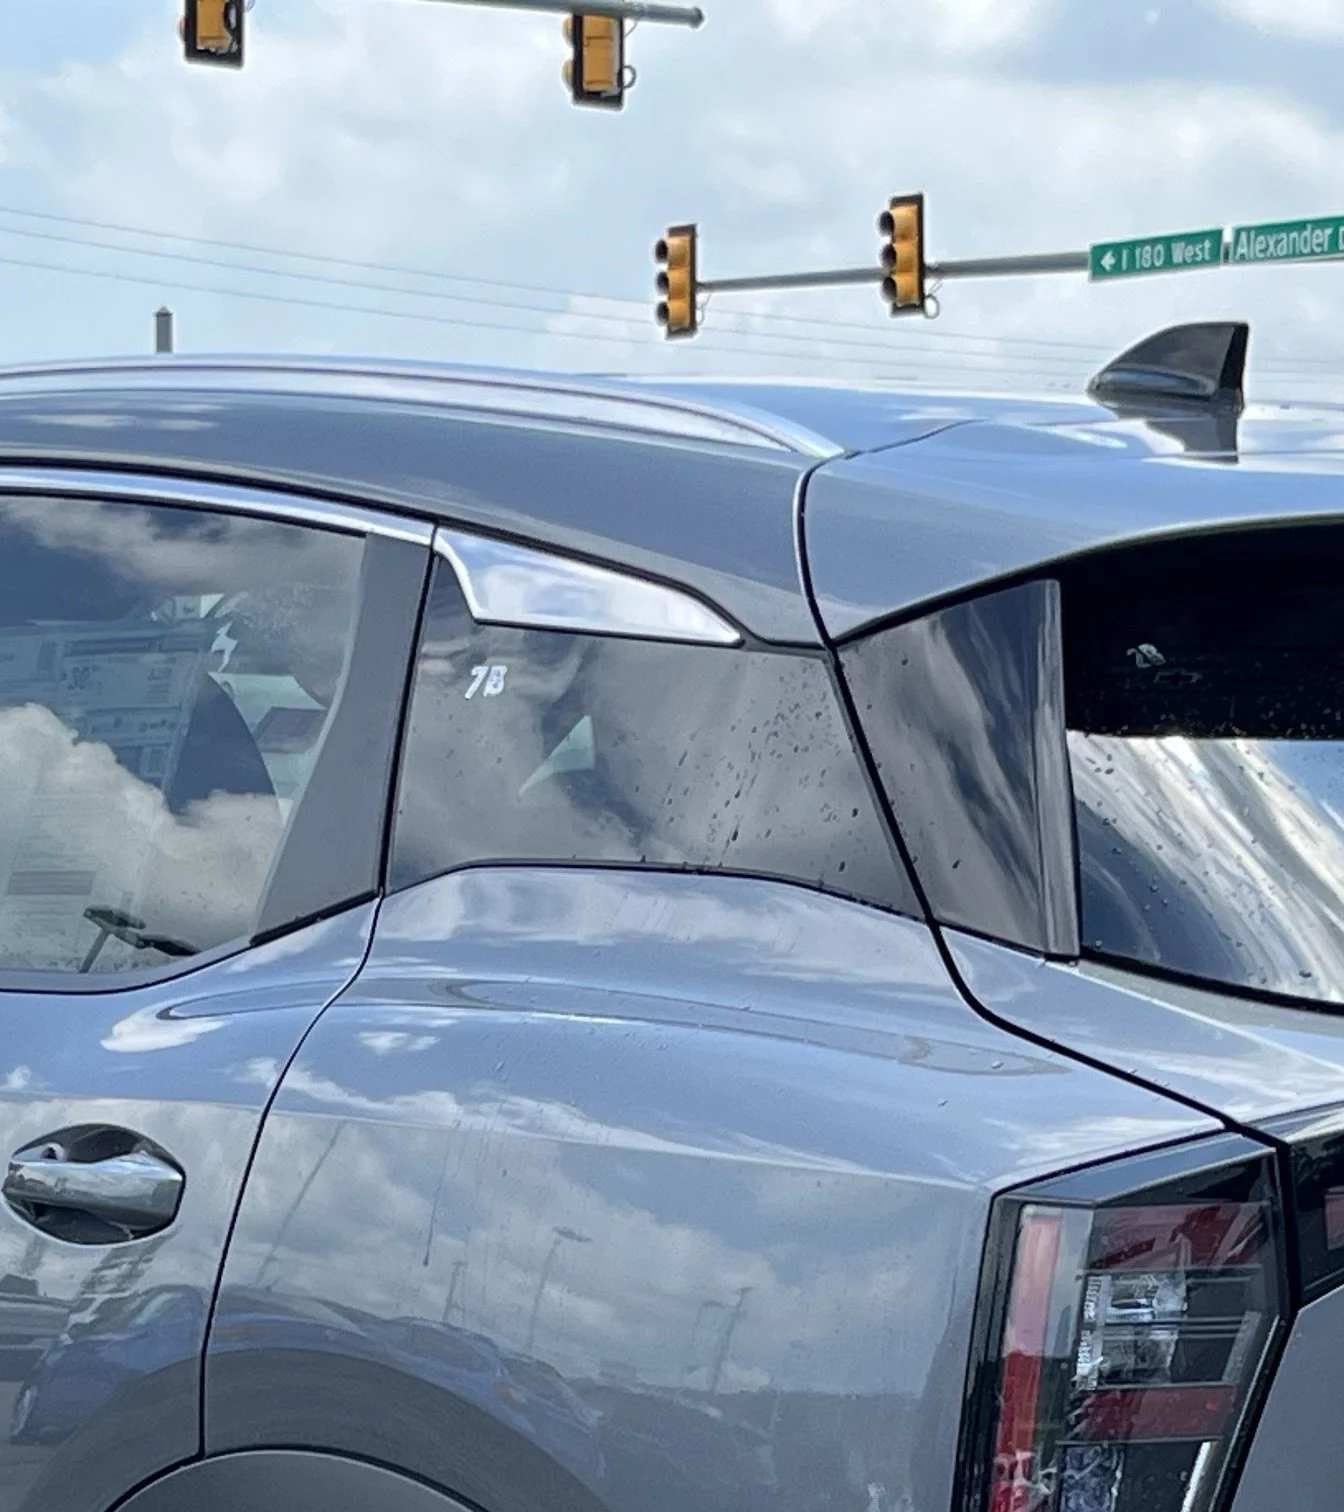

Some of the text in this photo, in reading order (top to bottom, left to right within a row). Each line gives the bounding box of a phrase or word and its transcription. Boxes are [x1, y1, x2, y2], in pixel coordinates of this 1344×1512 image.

[1135, 243, 1165, 269] 180
[1171, 239, 1212, 264] West
[1234, 223, 1334, 261] Alexander
